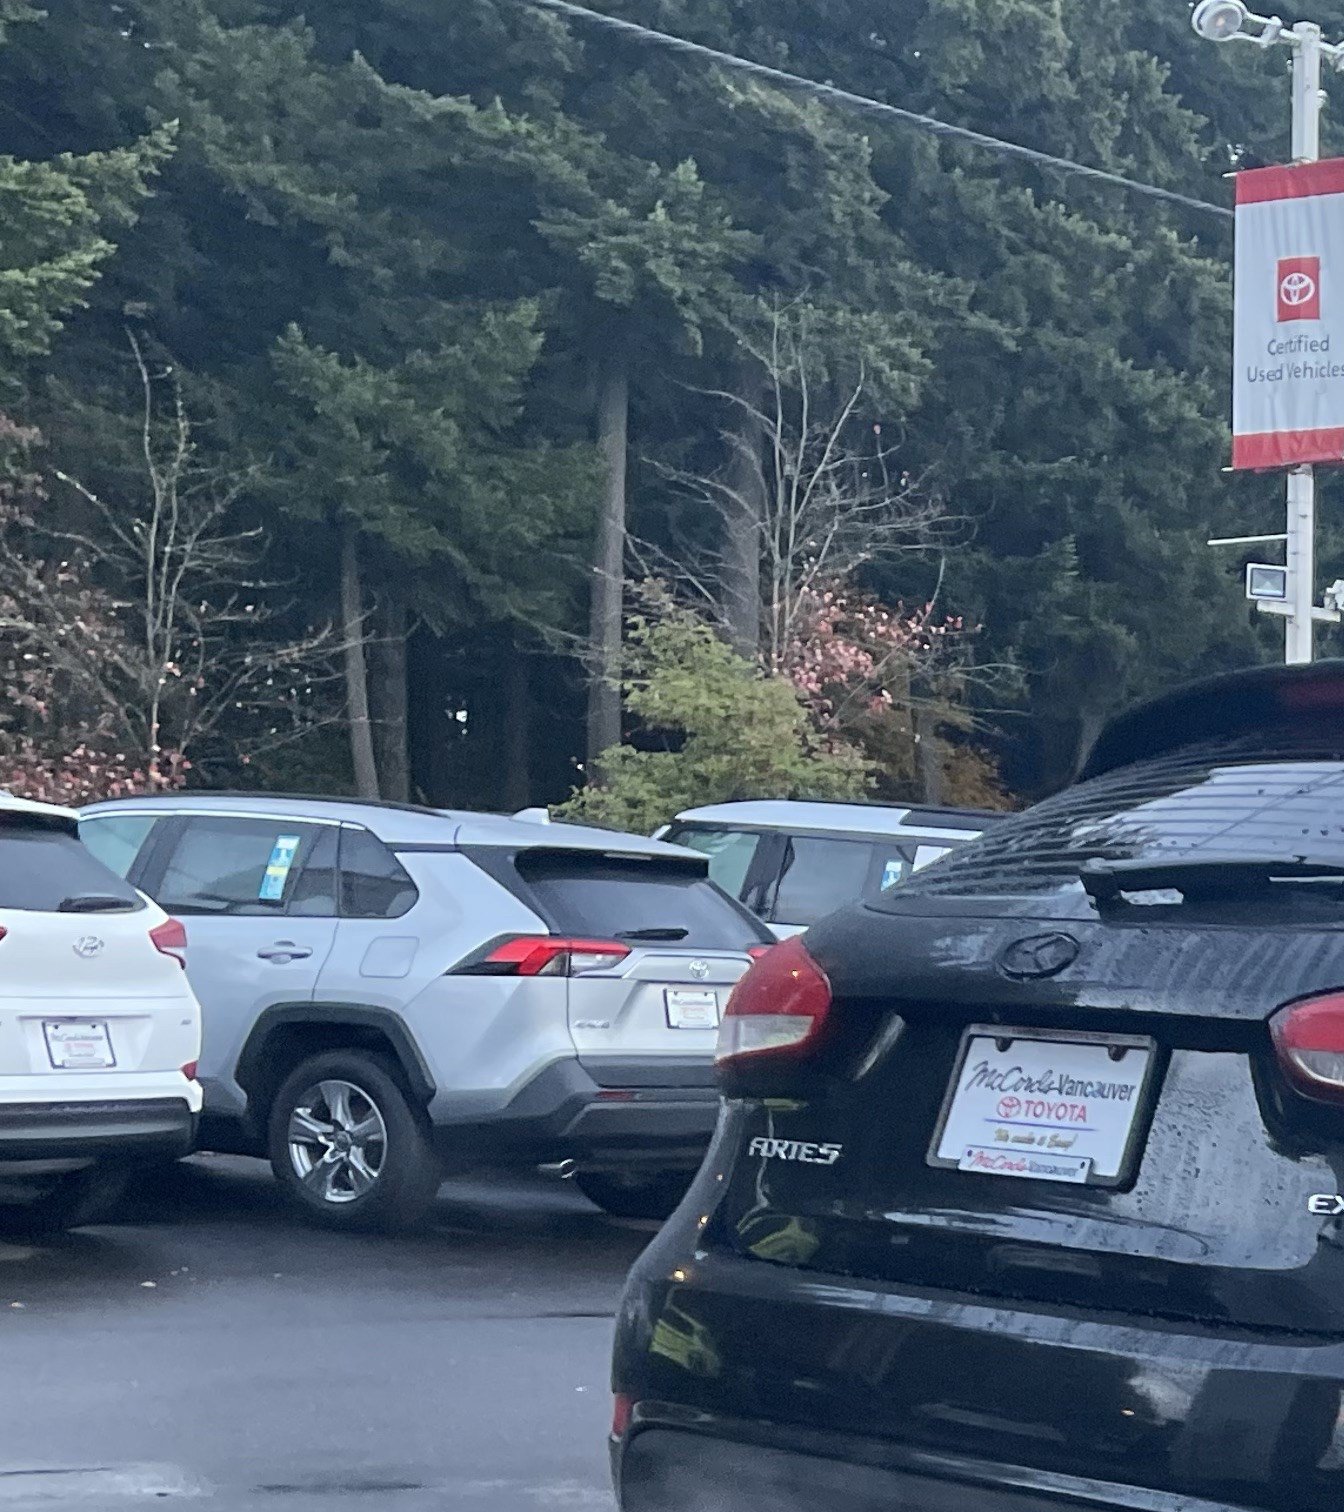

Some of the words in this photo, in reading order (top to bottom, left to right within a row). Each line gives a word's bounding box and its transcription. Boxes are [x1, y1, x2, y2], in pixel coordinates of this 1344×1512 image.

[1267, 334, 1330, 356] Certified
[1247, 363, 1283, 383] Used
[1024, 1100, 1087, 1122] TOYOTA
